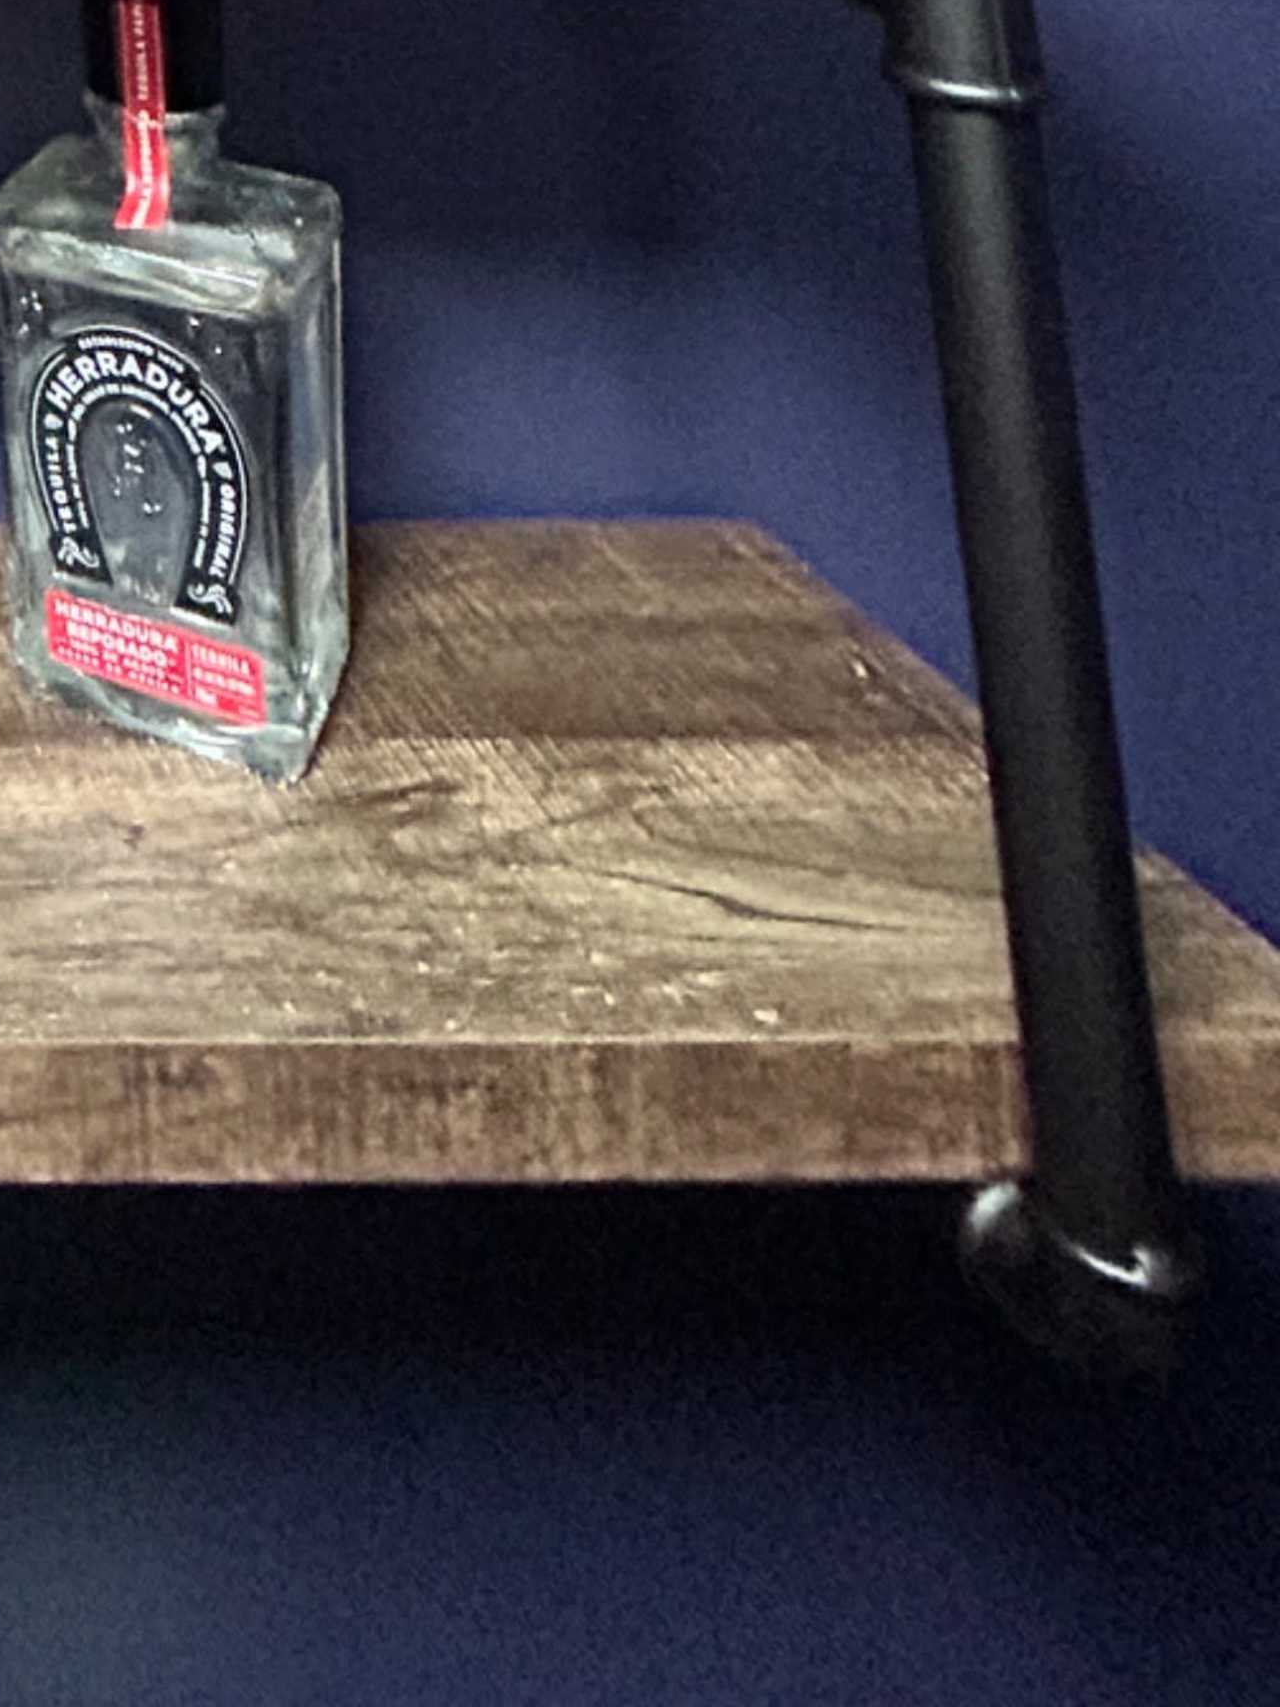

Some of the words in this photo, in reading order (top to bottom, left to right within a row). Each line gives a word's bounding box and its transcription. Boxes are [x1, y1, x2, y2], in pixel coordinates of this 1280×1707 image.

[45, 351, 223, 454] HERRADURA
[45, 437, 78, 534] TEQUILA
[208, 483, 237, 578] ORIGINAL
[54, 599, 178, 654] HERRADURA
